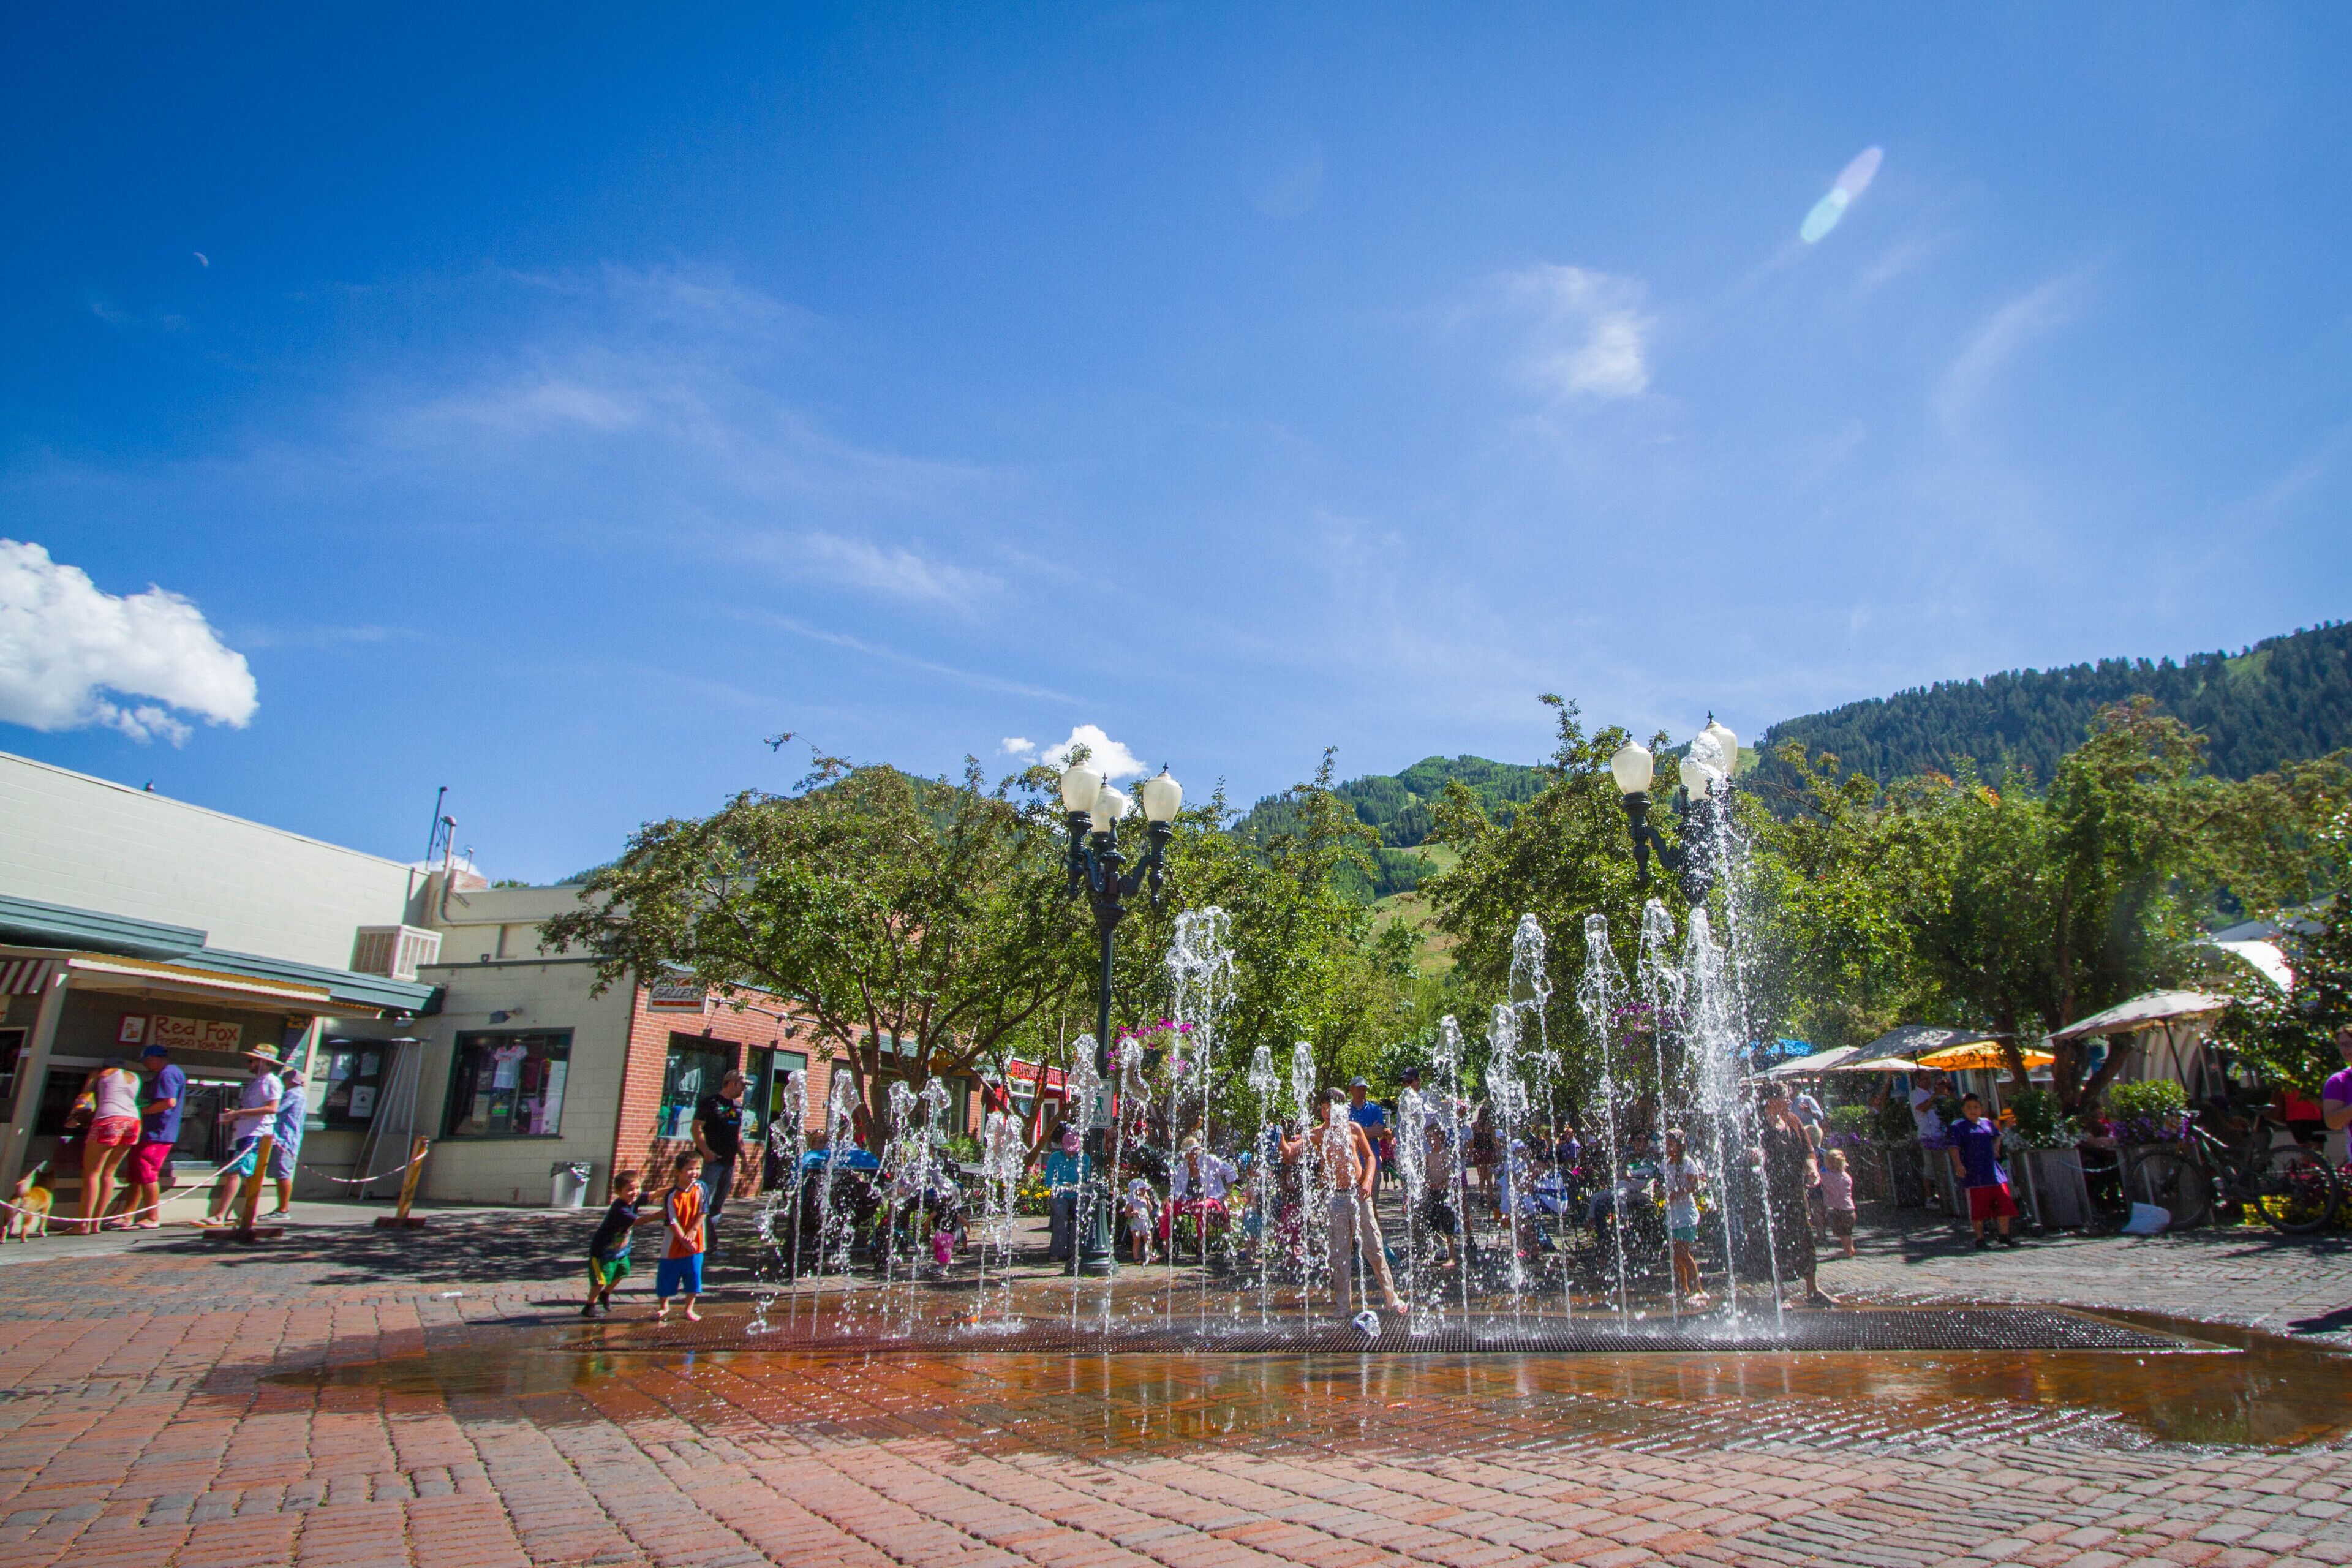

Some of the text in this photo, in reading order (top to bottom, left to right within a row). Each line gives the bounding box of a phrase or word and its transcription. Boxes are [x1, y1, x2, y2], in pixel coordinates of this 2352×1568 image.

[652, 987, 702, 999] GALLER
[156, 1016, 238, 1041] Red Fox
